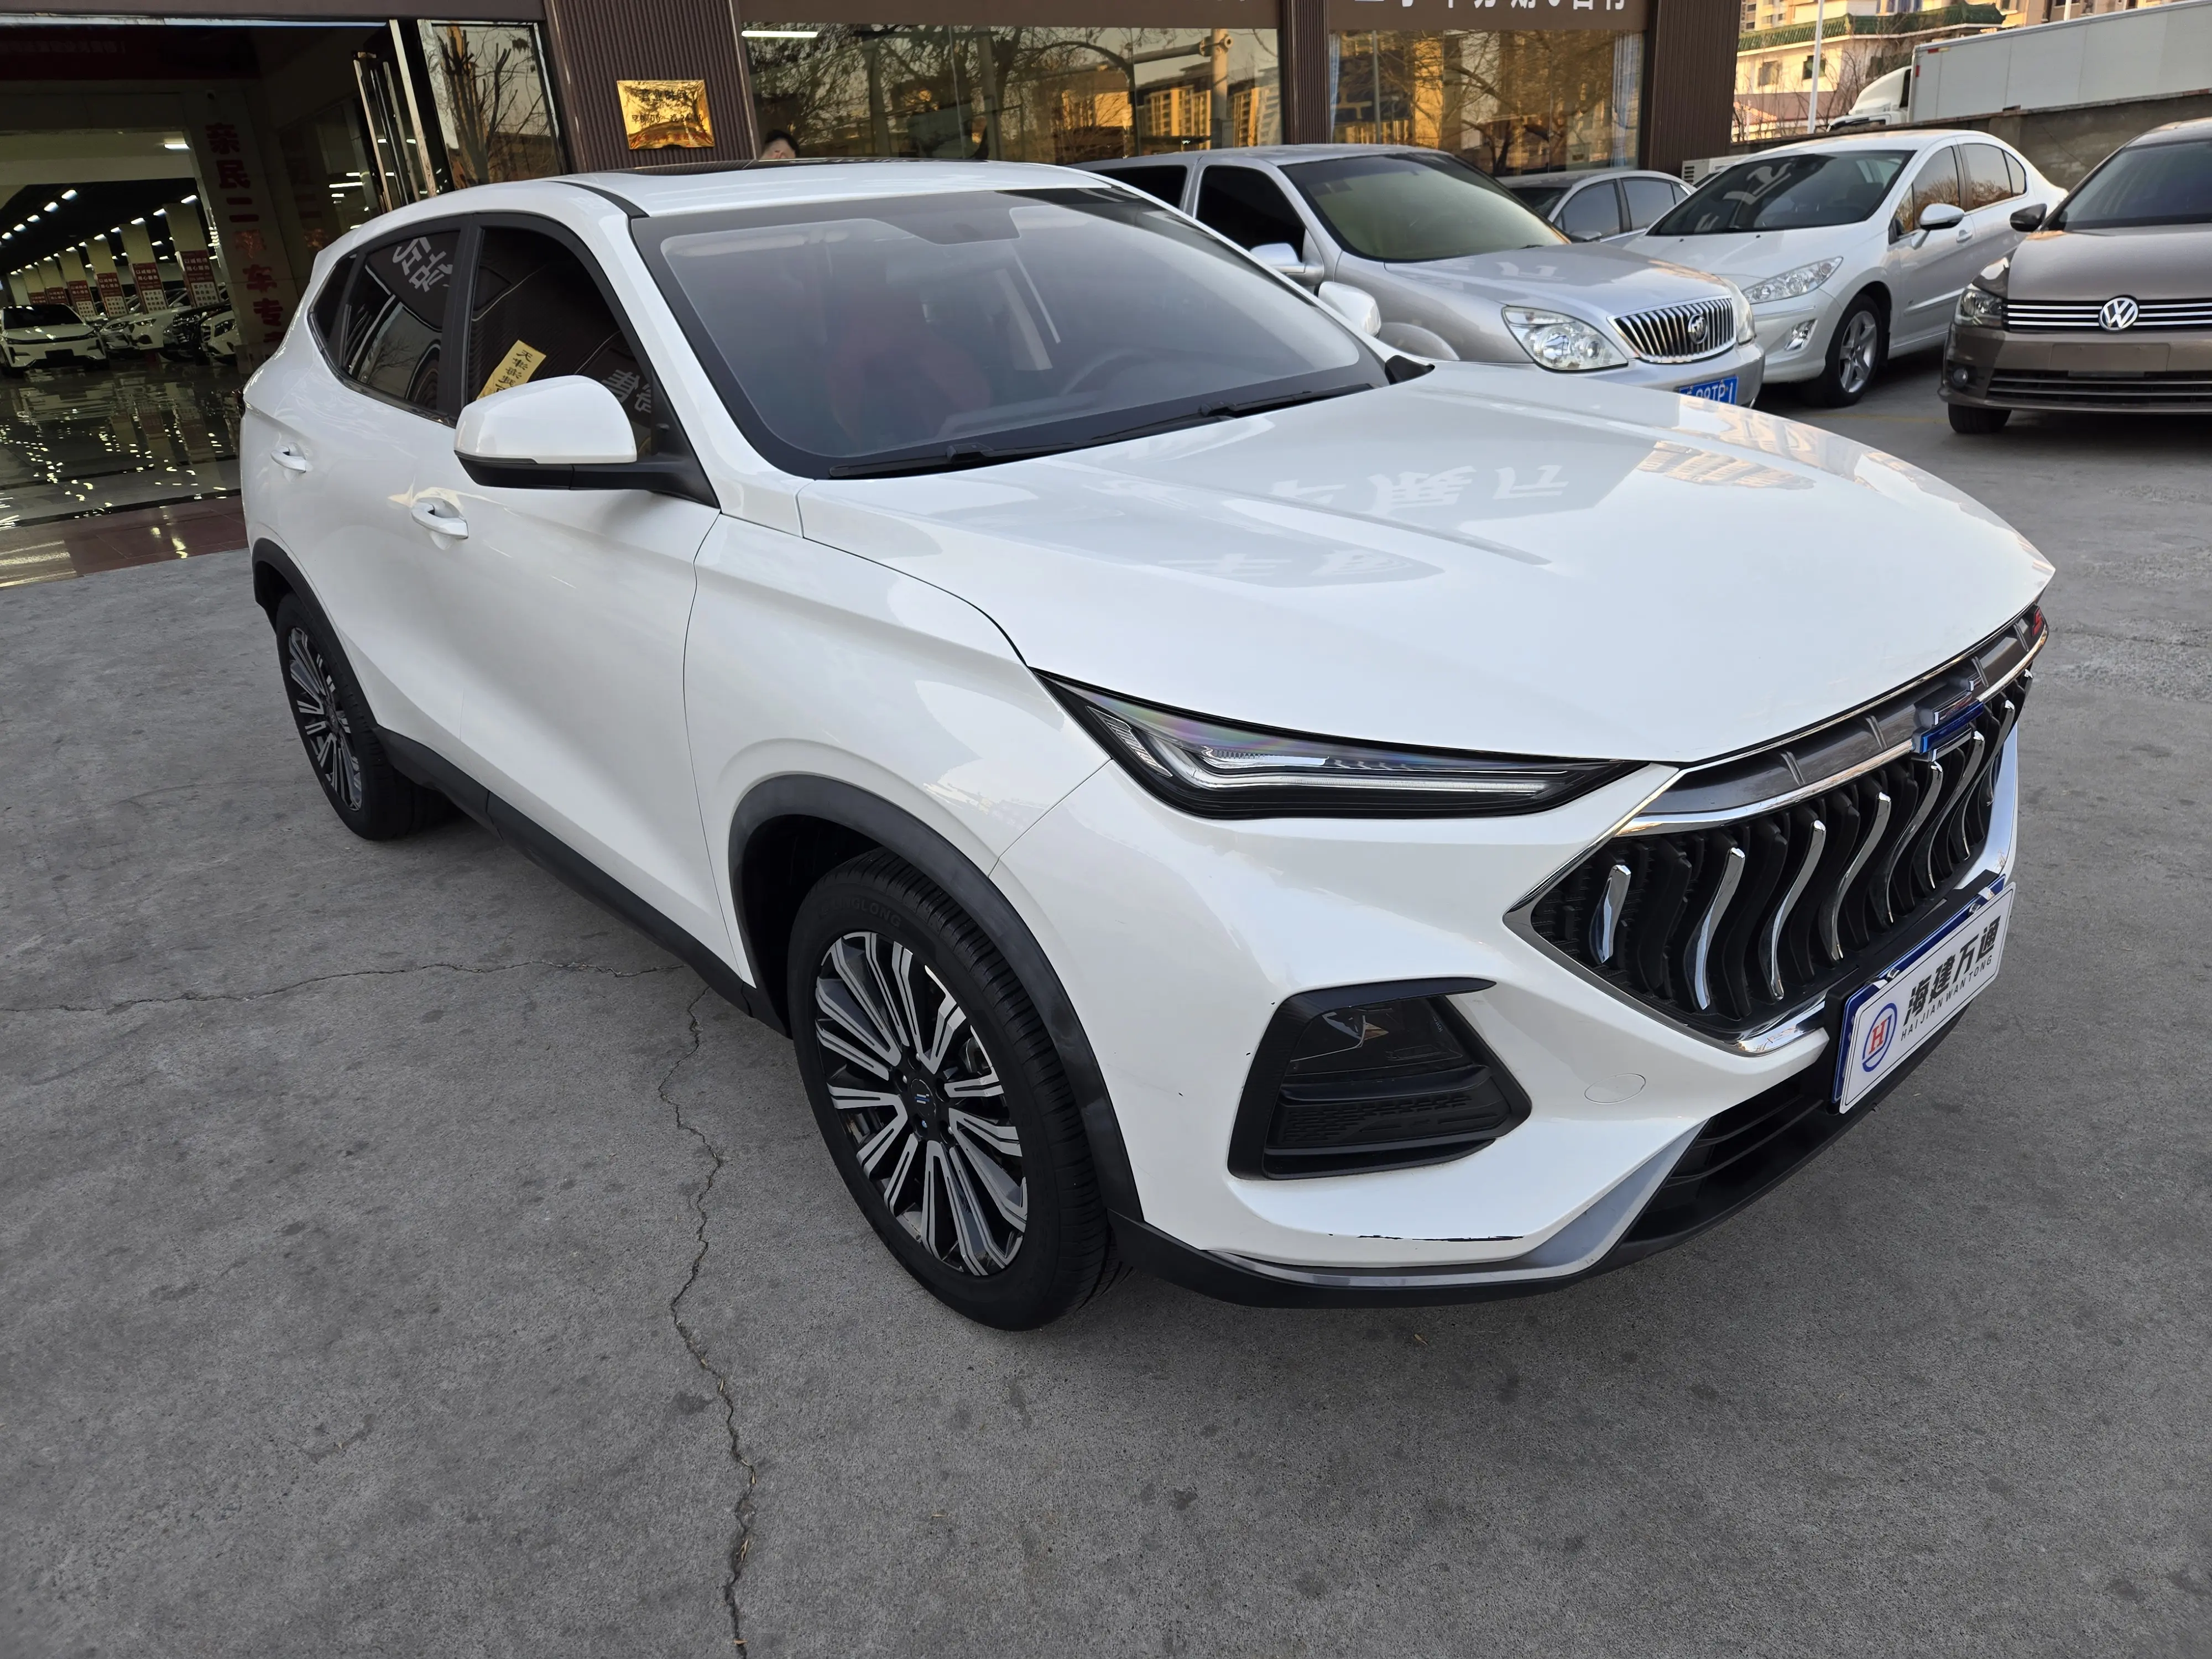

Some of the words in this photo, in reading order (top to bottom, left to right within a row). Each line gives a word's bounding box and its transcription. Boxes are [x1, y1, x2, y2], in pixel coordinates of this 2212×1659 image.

[833, 896, 901, 927] LINGLONG
[1903, 915, 2001, 1026] 海建万通
